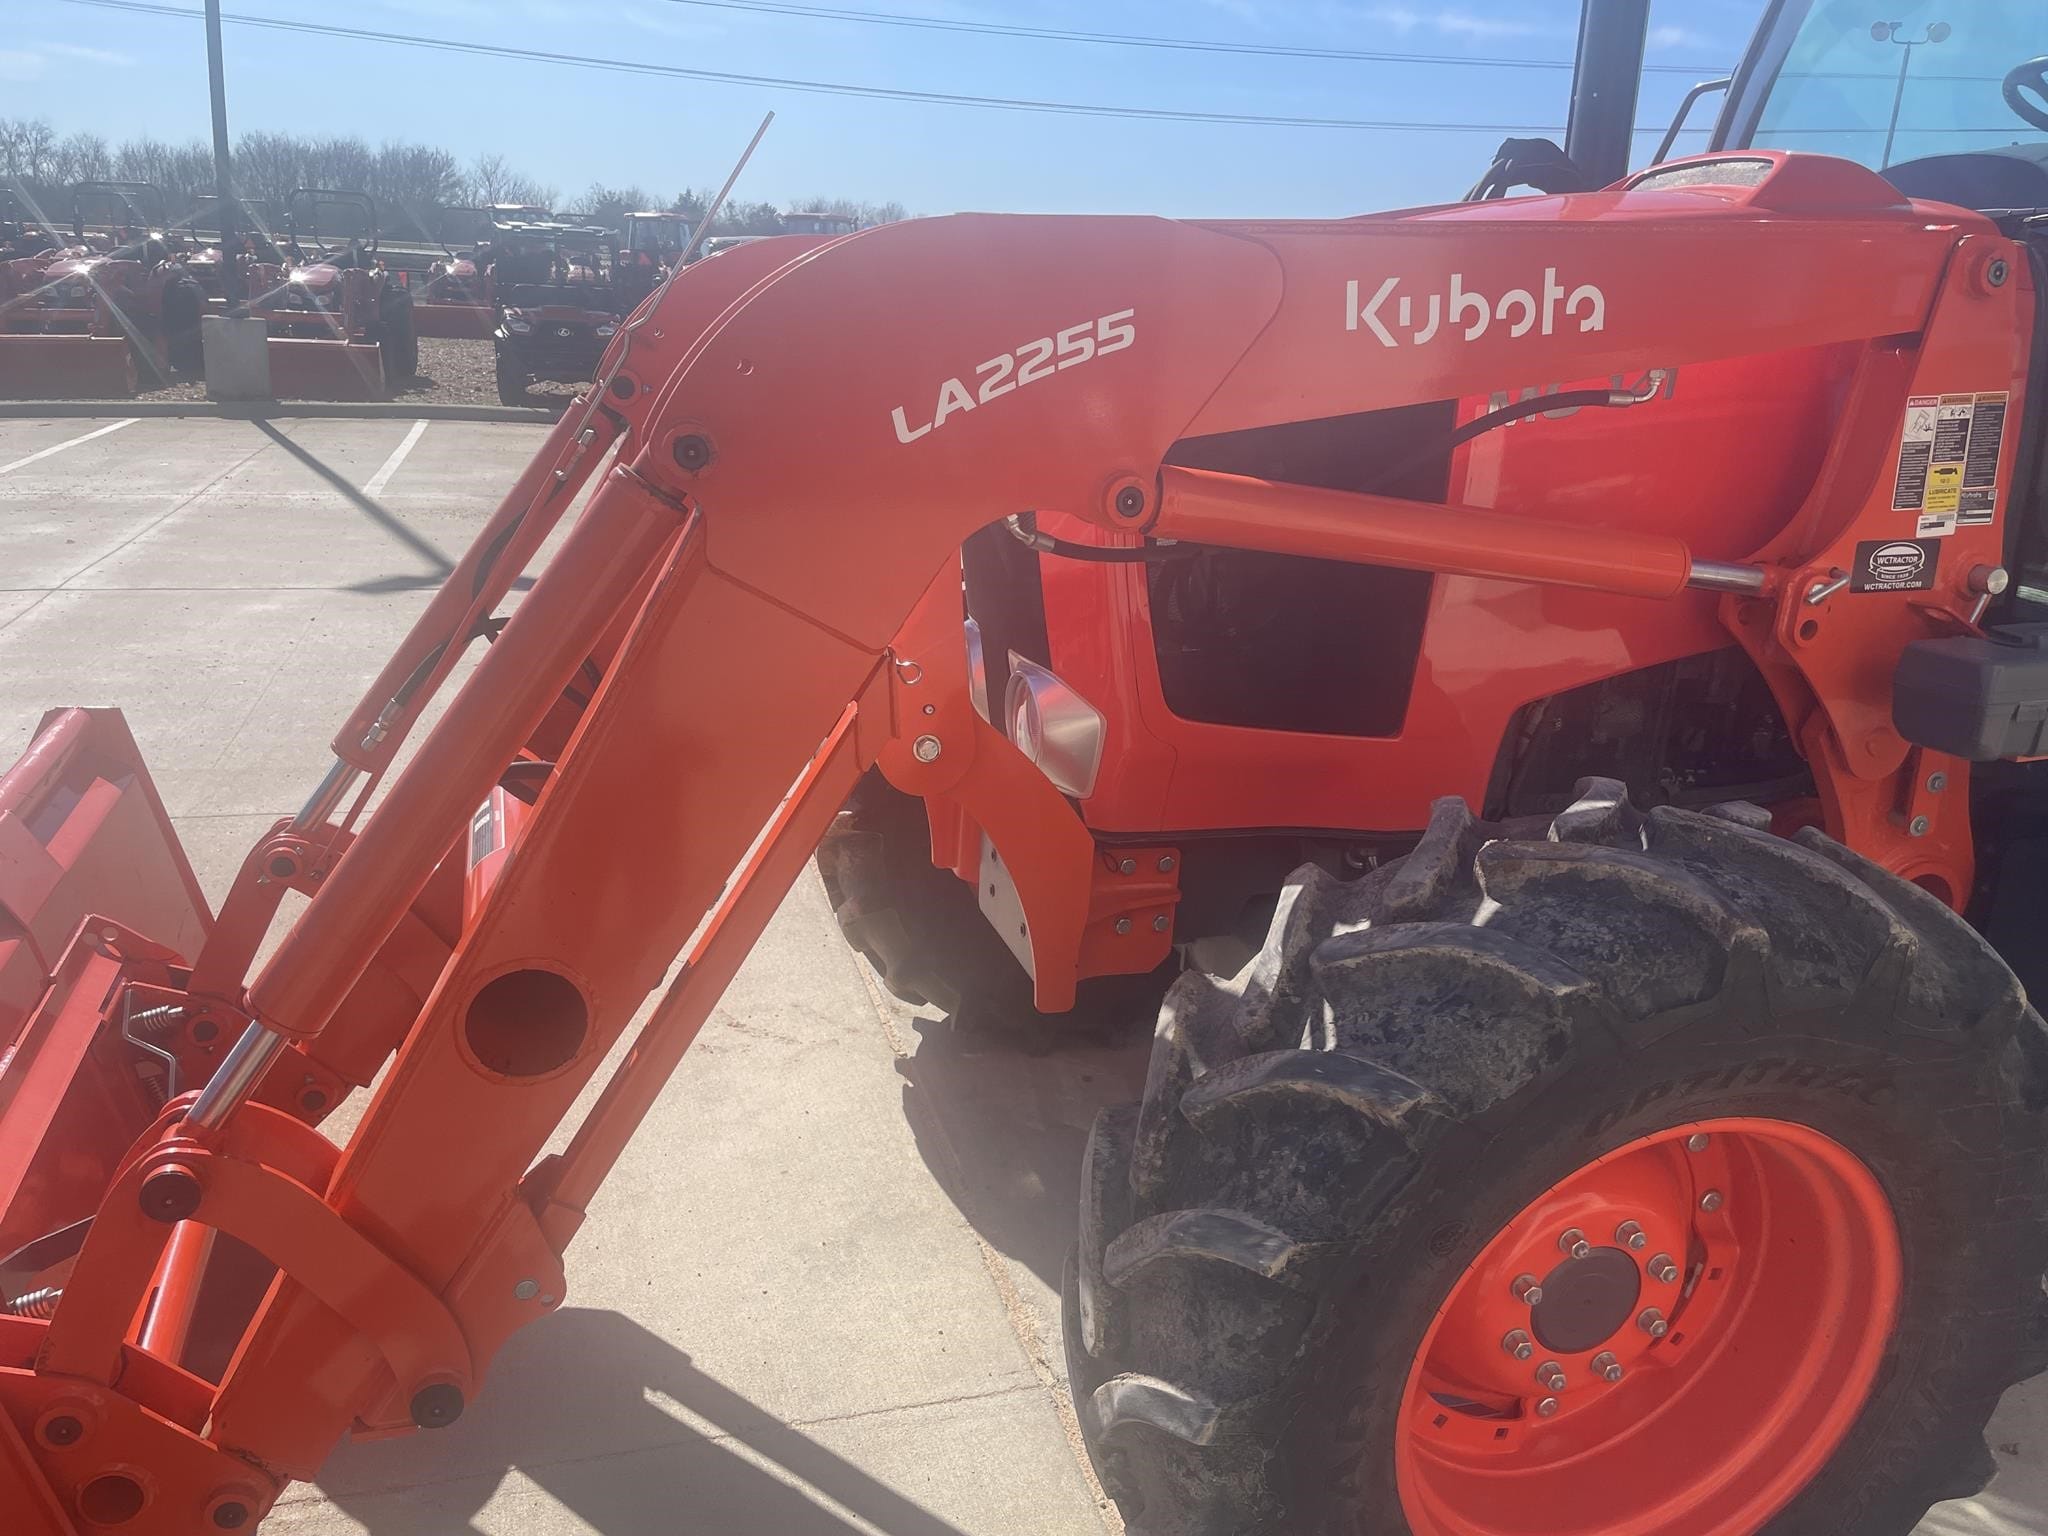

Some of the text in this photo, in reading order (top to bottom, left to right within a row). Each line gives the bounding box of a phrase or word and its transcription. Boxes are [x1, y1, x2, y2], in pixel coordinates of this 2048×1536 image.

[1345, 267, 1605, 347] Kubota
[891, 308, 1135, 444] LA2255
[1914, 399, 1938, 407] DANGER
[1877, 555, 1918, 564] WCTRACTOR
[1864, 581, 1922, 591] WCTRACTOR.COM
